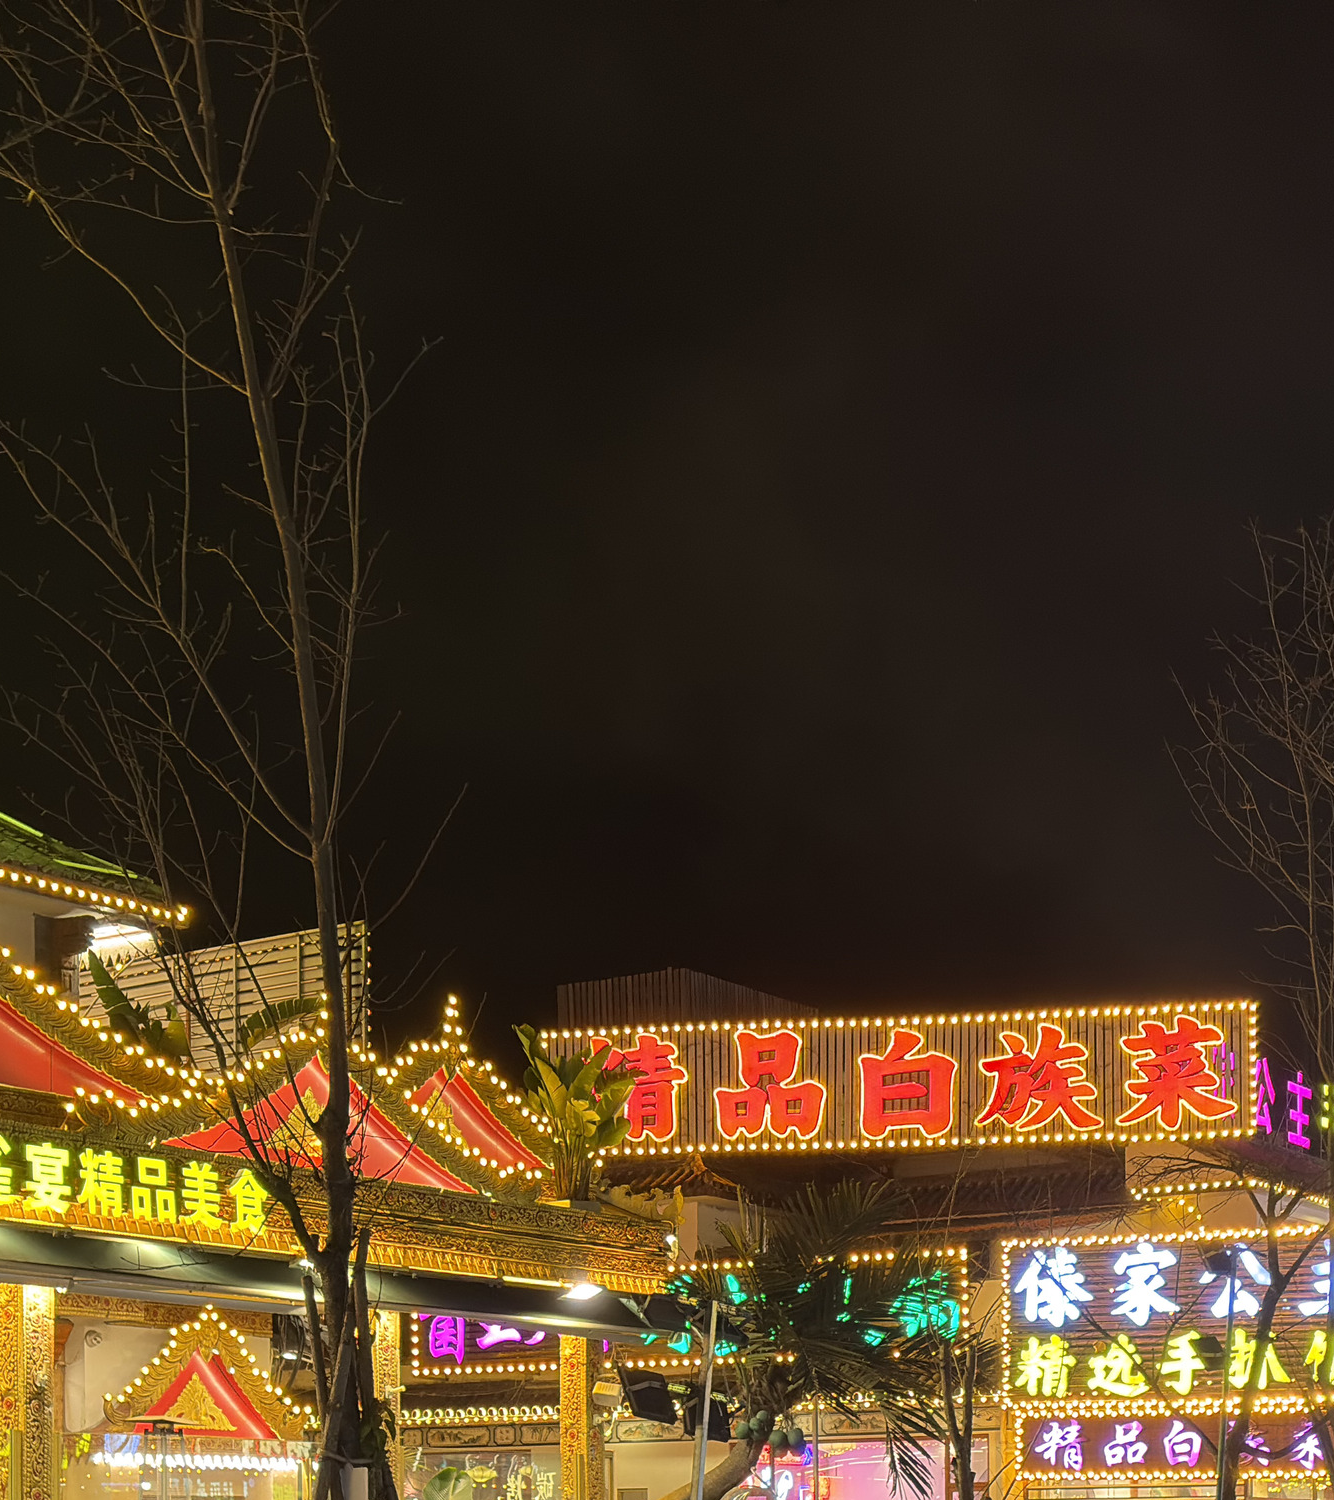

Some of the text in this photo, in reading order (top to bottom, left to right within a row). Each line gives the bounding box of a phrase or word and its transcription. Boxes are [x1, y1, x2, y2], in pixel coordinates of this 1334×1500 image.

[591, 1013, 1241, 1142] 精品白族菜
